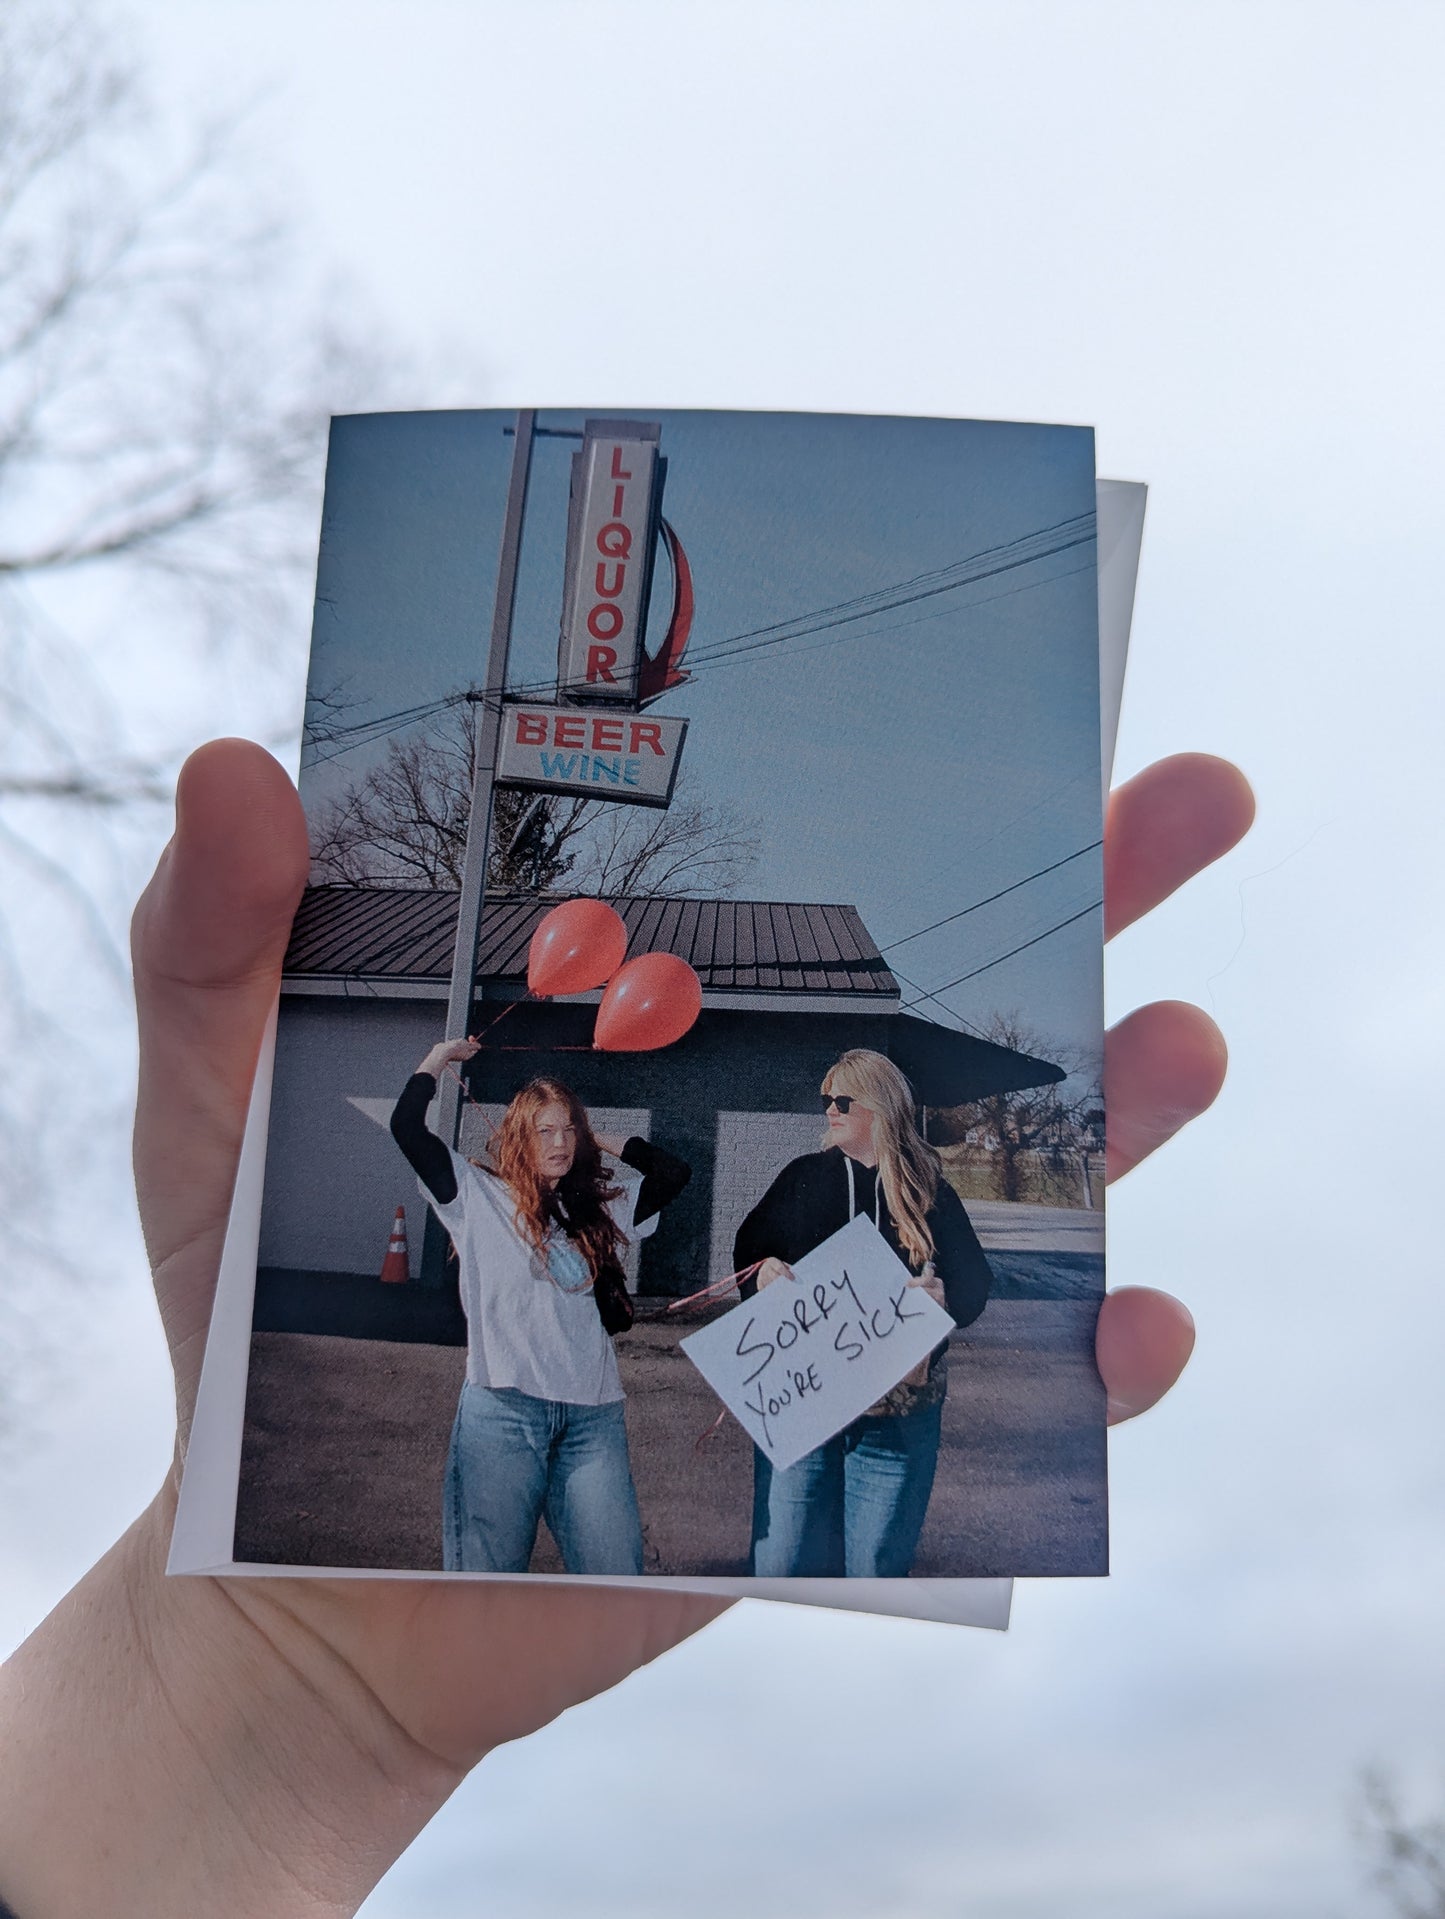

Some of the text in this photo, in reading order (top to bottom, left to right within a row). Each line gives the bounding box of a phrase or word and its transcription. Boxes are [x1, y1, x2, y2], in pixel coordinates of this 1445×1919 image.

[585, 447, 632, 684] LIQUOR
[515, 712, 665, 756] BEER
[540, 752, 641, 786] WINE
[736, 1270, 866, 1386] SORRY
[834, 1287, 924, 1361] SICK
